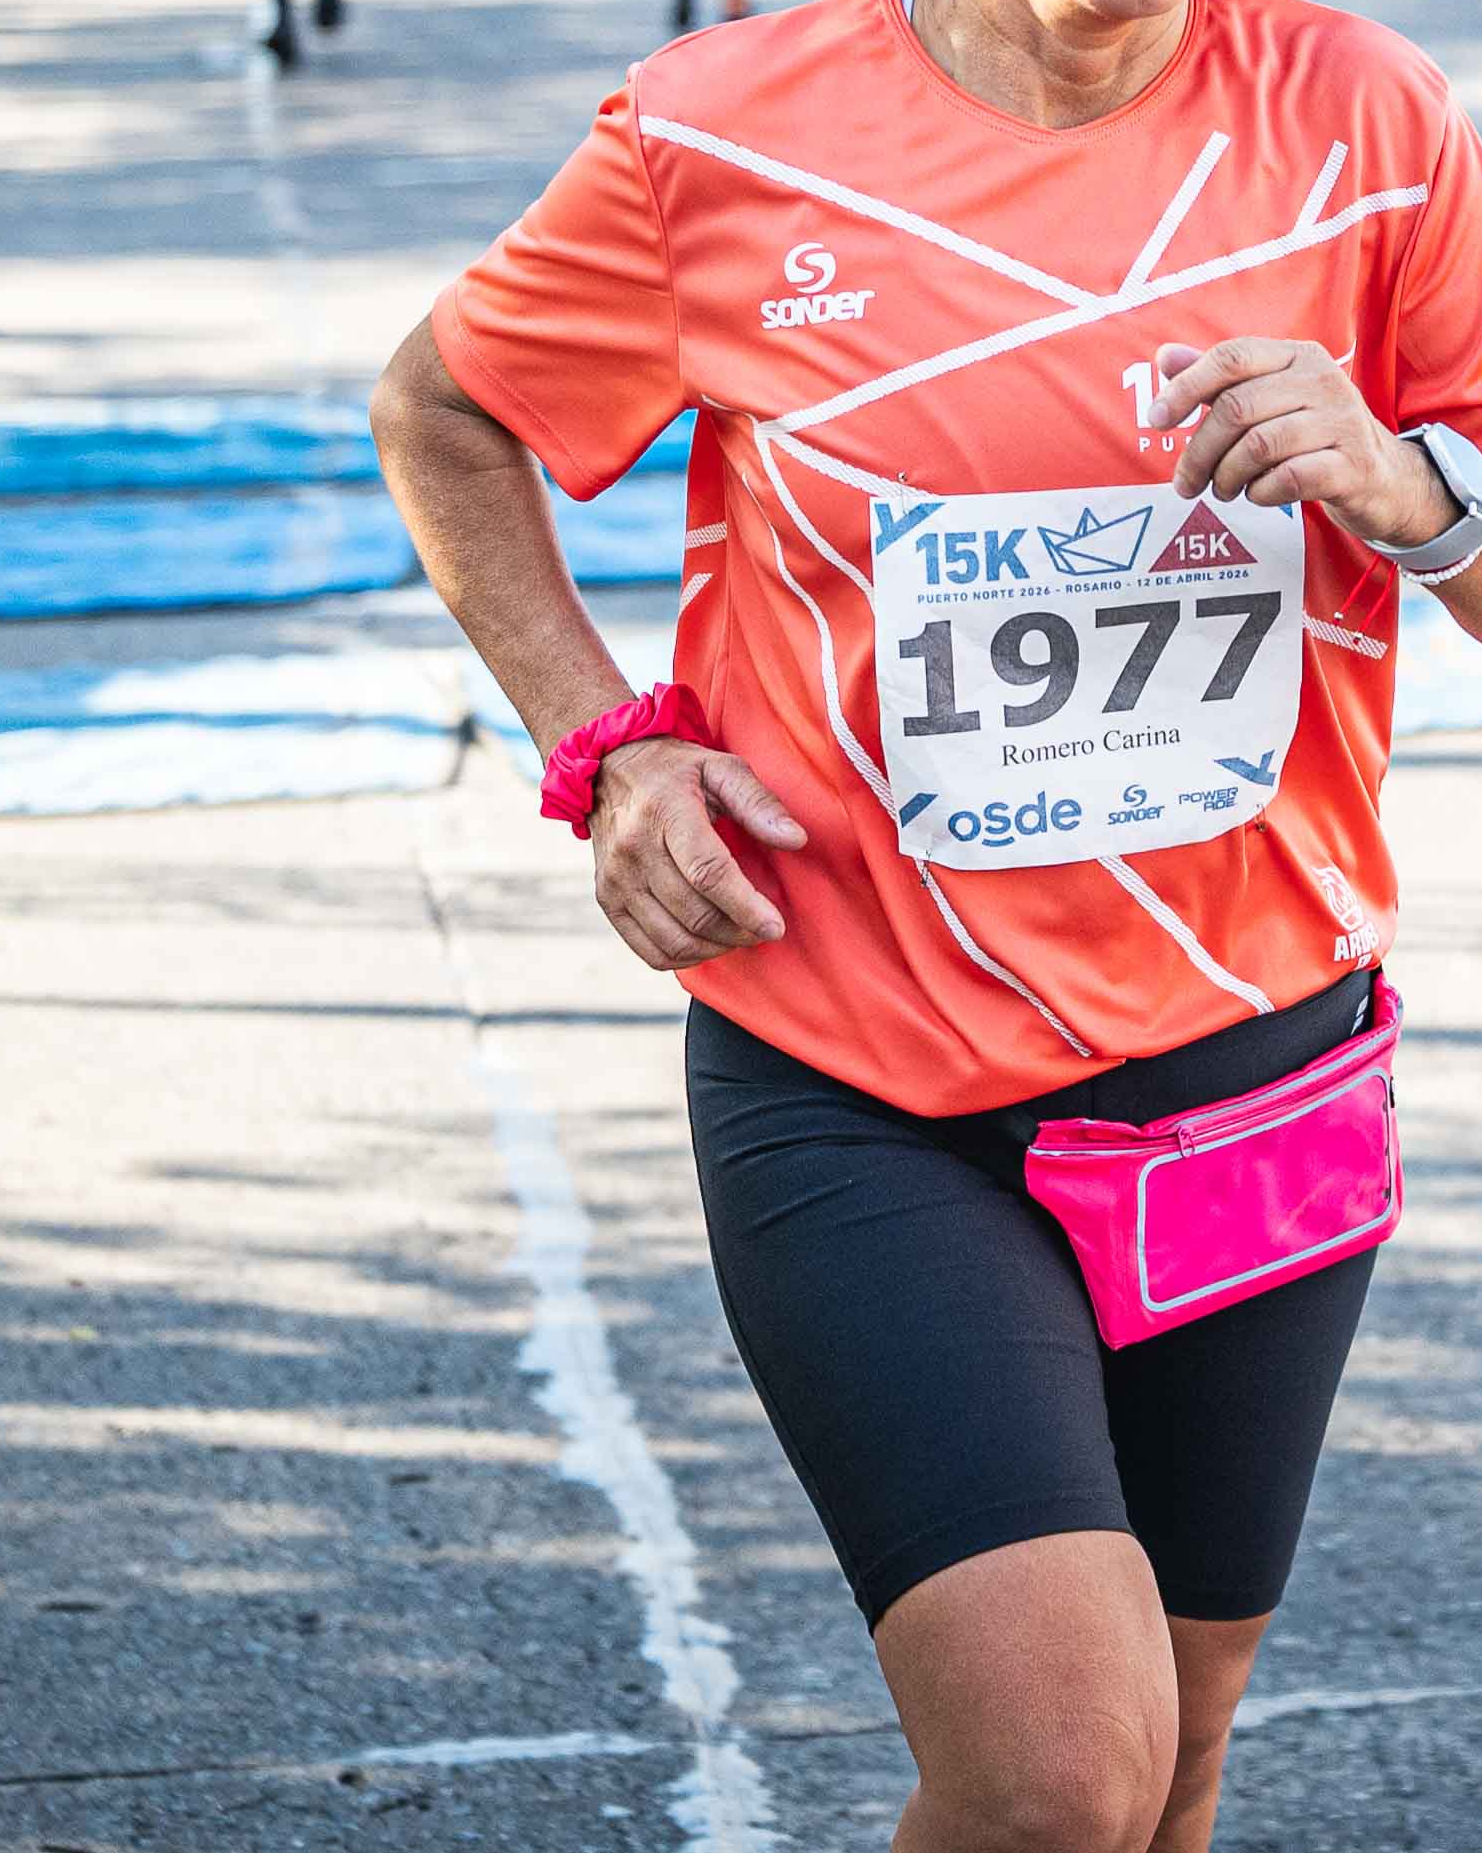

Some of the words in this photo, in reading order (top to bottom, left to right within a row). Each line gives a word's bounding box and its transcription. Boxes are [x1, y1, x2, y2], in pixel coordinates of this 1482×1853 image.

[915, 528, 1031, 585] 15K
[1174, 531, 1231, 561] 15K
[917, 592, 968, 604] PUERTO
[973, 589, 1015, 600] NORTE
[1020, 587, 1051, 597] 2026
[1065, 580, 1122, 594] ROSARIO
[1137, 578, 1151, 588] 12
[1156, 576, 1173, 586] DE
[1177, 573, 1214, 585] ABRIL
[1218, 569, 1250, 581] 2026
[899, 590, 1282, 737] 1977
[1002, 736, 1095, 767] Romero
[1103, 725, 1181, 753] Carina
[948, 790, 1083, 843] osde
[1178, 786, 1239, 805] POWER
